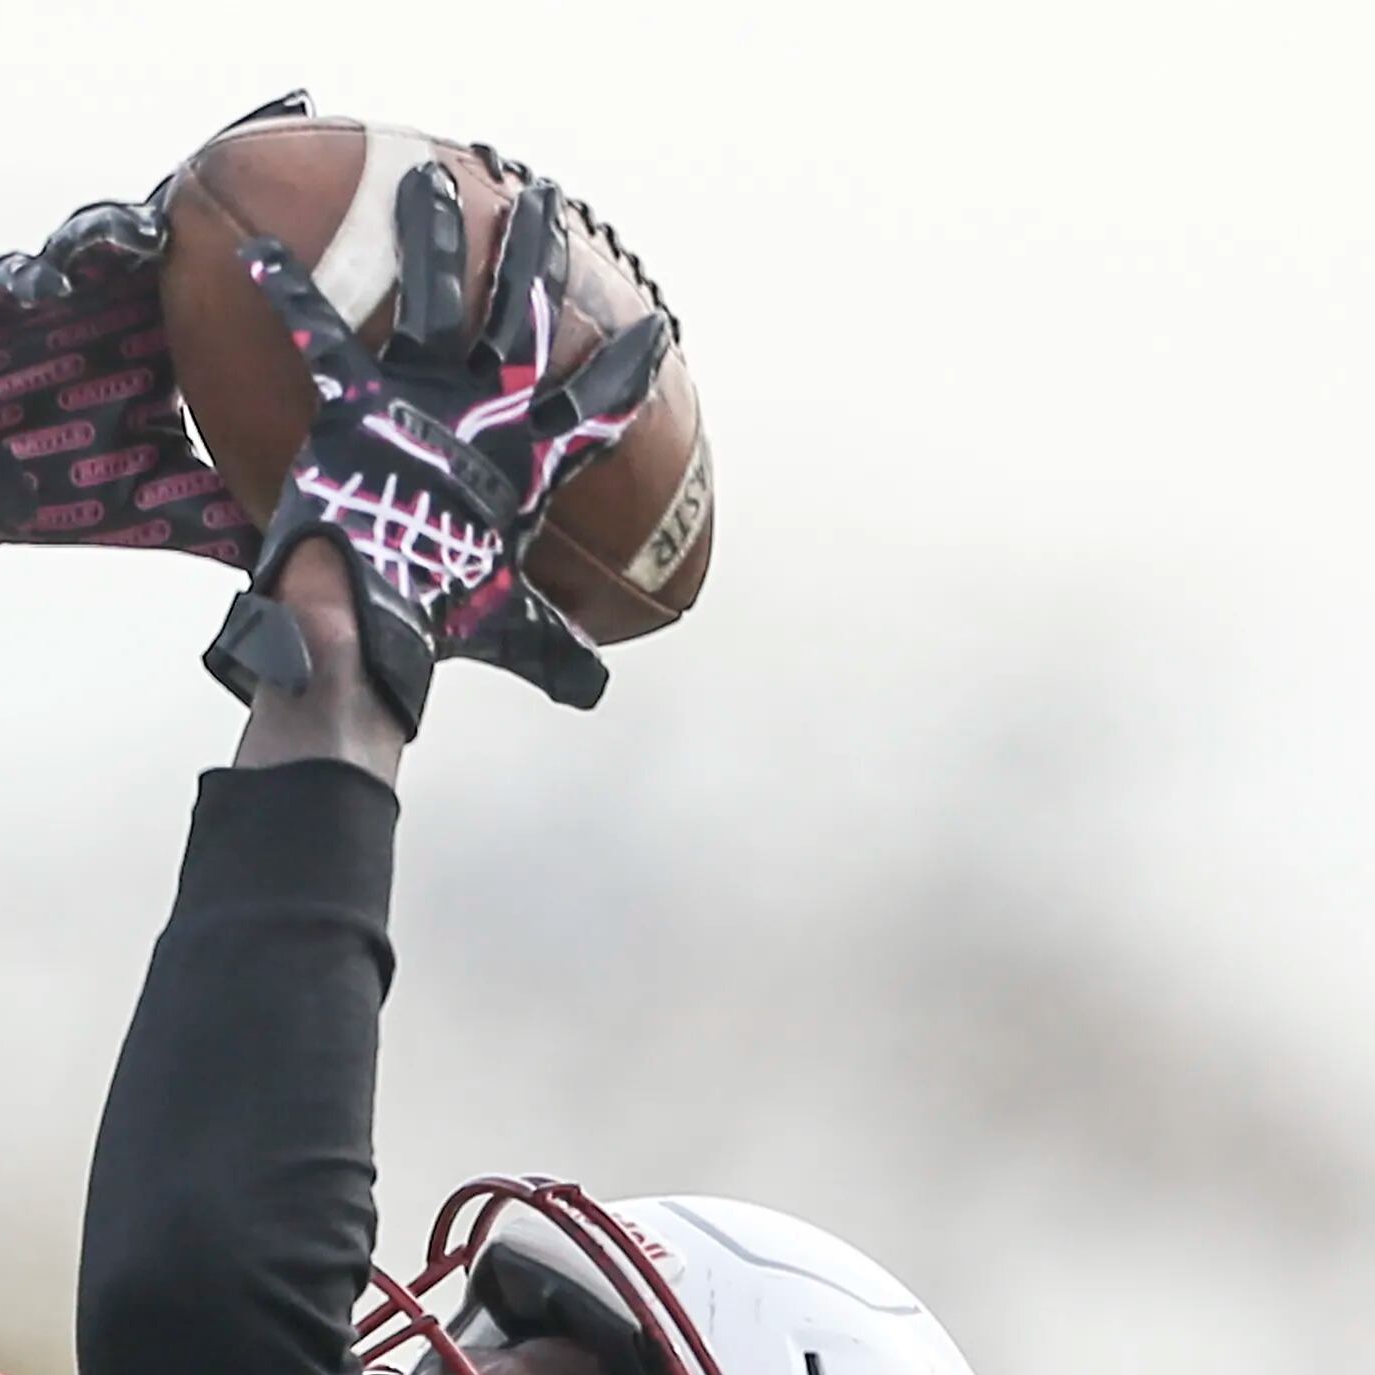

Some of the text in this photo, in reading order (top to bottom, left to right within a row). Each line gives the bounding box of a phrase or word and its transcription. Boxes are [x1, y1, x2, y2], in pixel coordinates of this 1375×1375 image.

[60, 369, 151, 409] BATTLE
[73, 447, 158, 486] BATTLE
[136, 470, 221, 508] BATTLE
